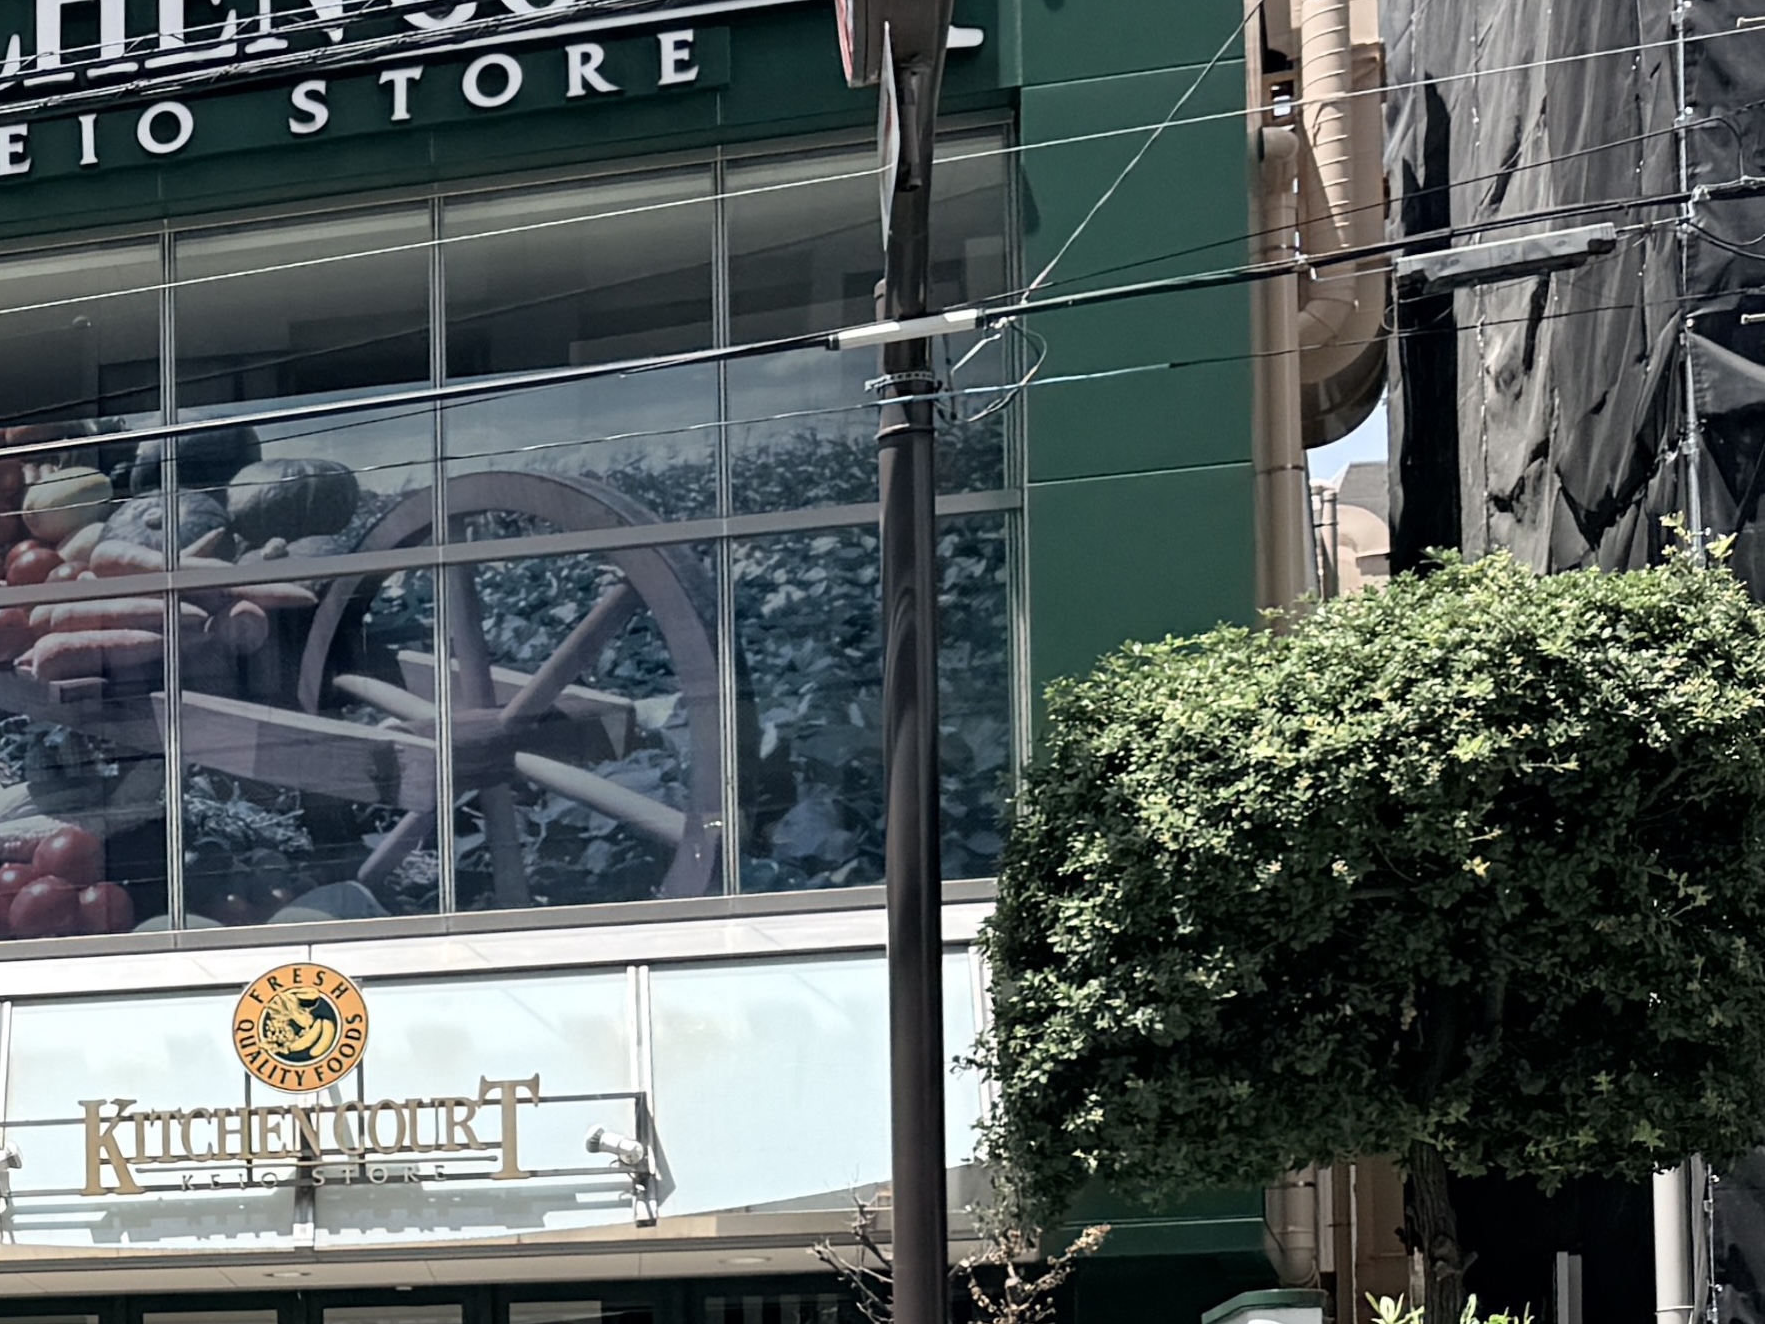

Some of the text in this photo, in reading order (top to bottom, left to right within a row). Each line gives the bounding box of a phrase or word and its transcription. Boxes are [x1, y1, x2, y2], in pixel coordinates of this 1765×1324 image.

[287, 30, 698, 137] STORE
[249, 968, 346, 1004] FRESH
[237, 1013, 364, 1087] QUALITY FOODS
[78, 1073, 540, 1195] KITCHEN COURT
[182, 1165, 447, 1191] KEIO STORE
